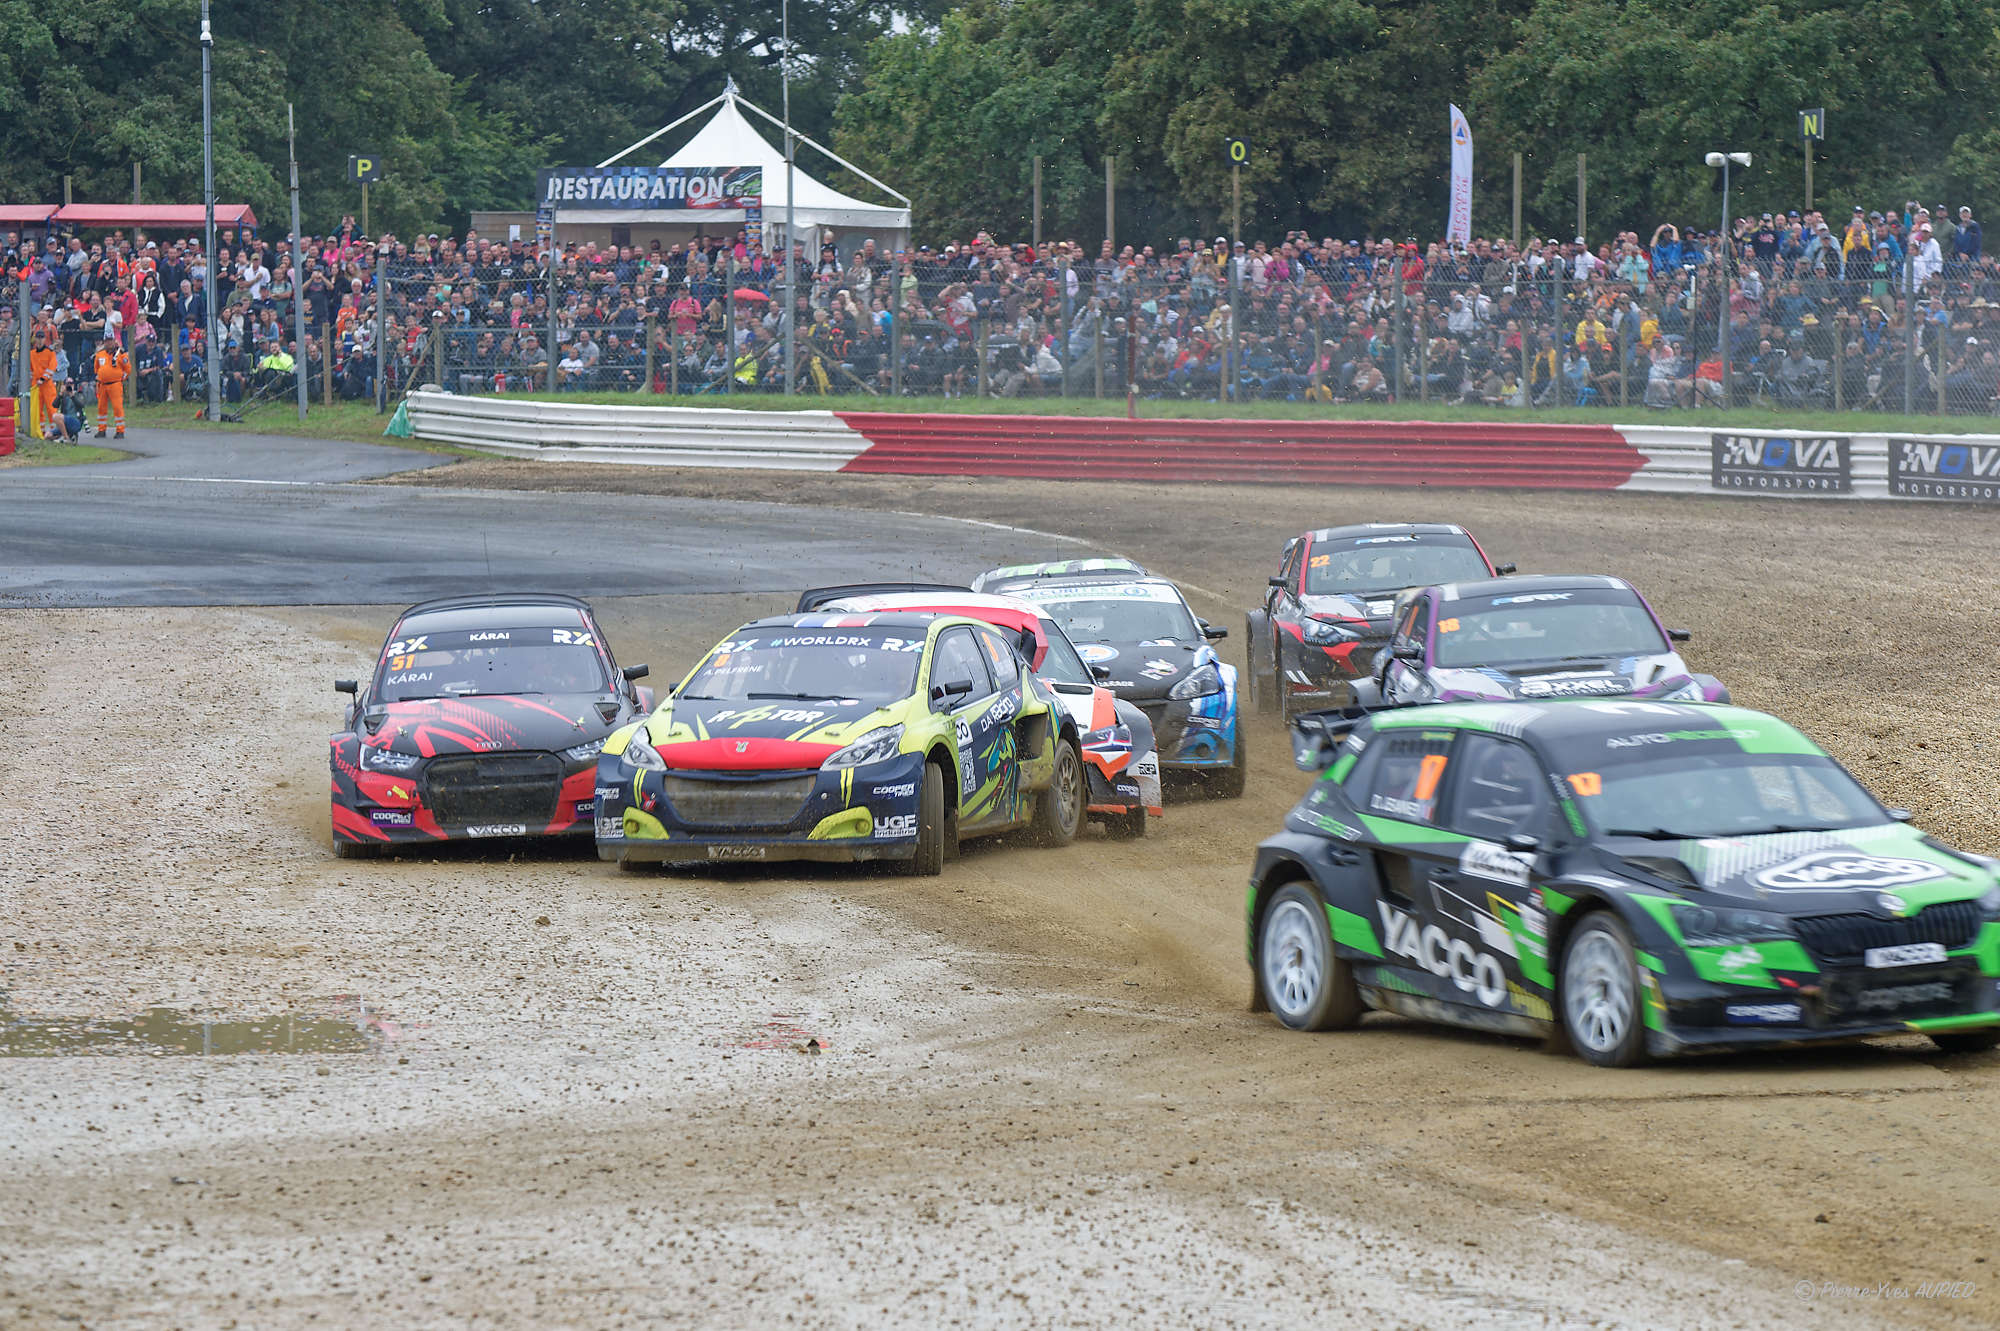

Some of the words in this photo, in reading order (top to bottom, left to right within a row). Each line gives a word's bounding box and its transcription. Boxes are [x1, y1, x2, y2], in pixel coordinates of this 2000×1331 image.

[1803, 113, 1818, 136] N
[357, 159, 373, 177] P
[547, 176, 724, 200] RESTAURATION
[1732, 437, 1841, 469] NOVA
[1720, 474, 1841, 490] MOTORSPORT
[1897, 482, 2000, 498] MOTORSPO
[1310, 554, 1330, 569] 22
[387, 635, 429, 658] RX
[552, 628, 596, 647] RX
[713, 638, 760, 655] RX
[770, 636, 872, 647] #WORLDRX
[880, 637, 926, 653] RX
[391, 653, 415, 672] 51
[1375, 898, 1509, 1008] YACCO
